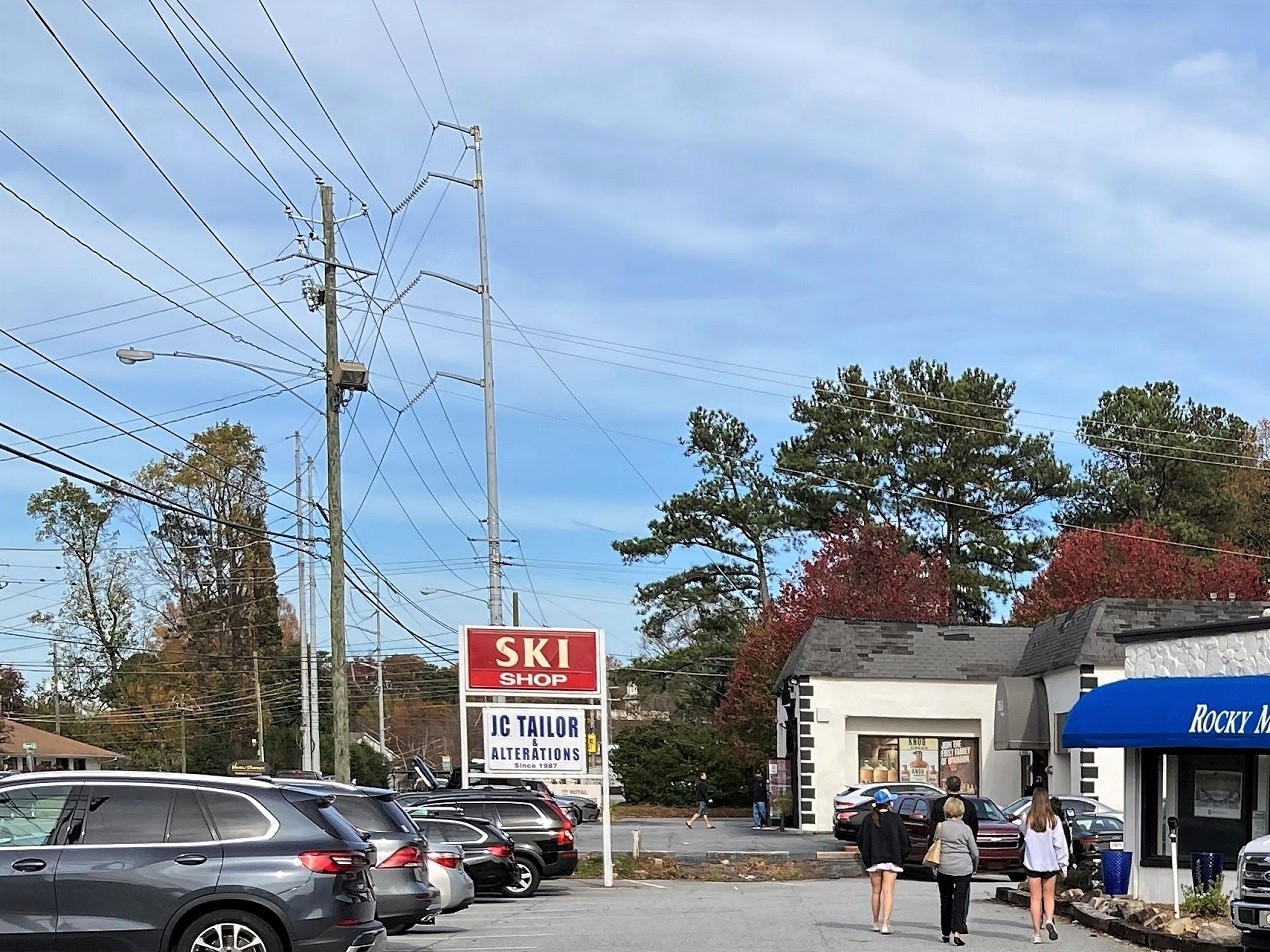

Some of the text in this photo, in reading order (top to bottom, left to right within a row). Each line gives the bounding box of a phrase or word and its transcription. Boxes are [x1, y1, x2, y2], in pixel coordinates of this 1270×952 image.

[495, 636, 570, 669] SKI
[498, 672, 568, 687] SHOP
[516, 715, 579, 738] TAILOR
[1188, 703, 1254, 734] ROCKY
[532, 737, 539, 747] &
[491, 747, 580, 761] ALTERATIONS
